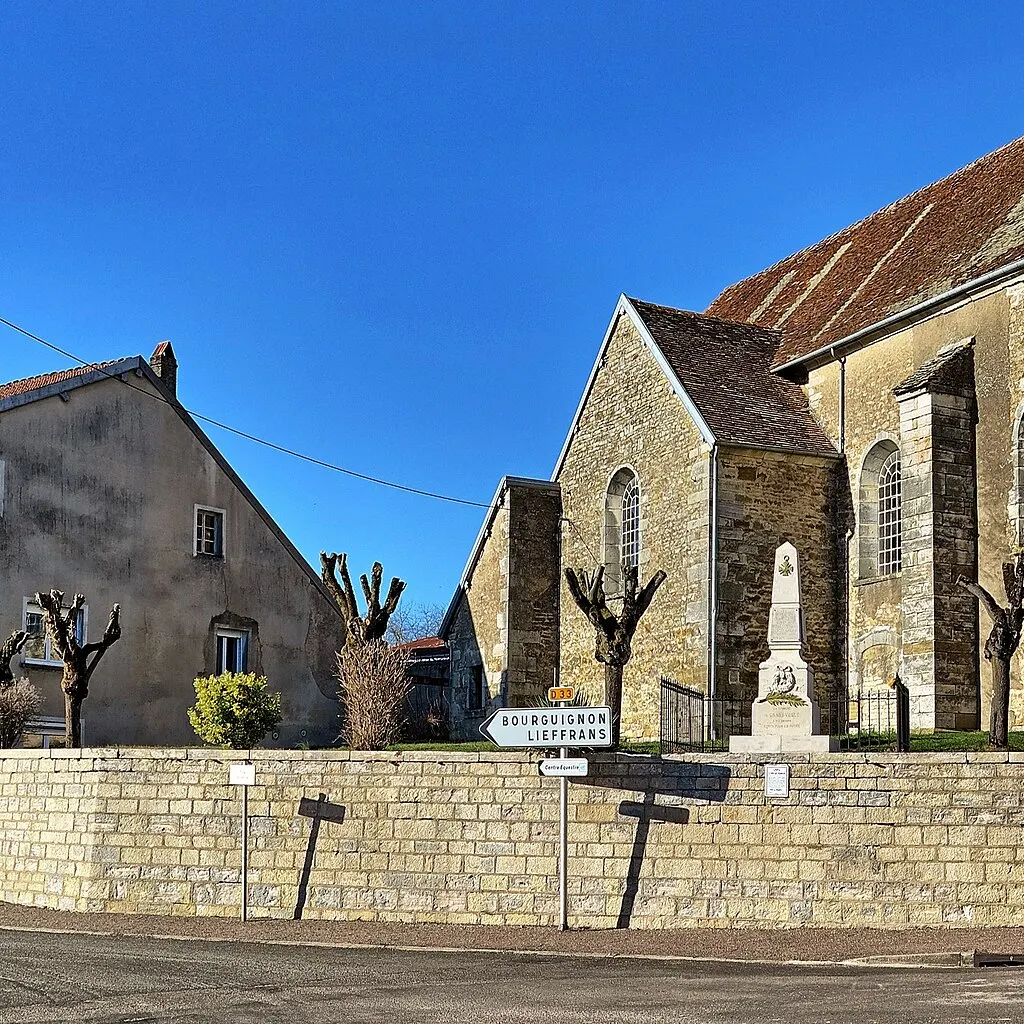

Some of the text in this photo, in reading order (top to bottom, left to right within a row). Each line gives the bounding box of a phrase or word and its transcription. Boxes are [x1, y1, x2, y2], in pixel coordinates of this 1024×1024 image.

[551, 689, 572, 699] D 33
[502, 713, 606, 726] BOURGUIGNON
[528, 728, 606, 741] LIEFFRANS
